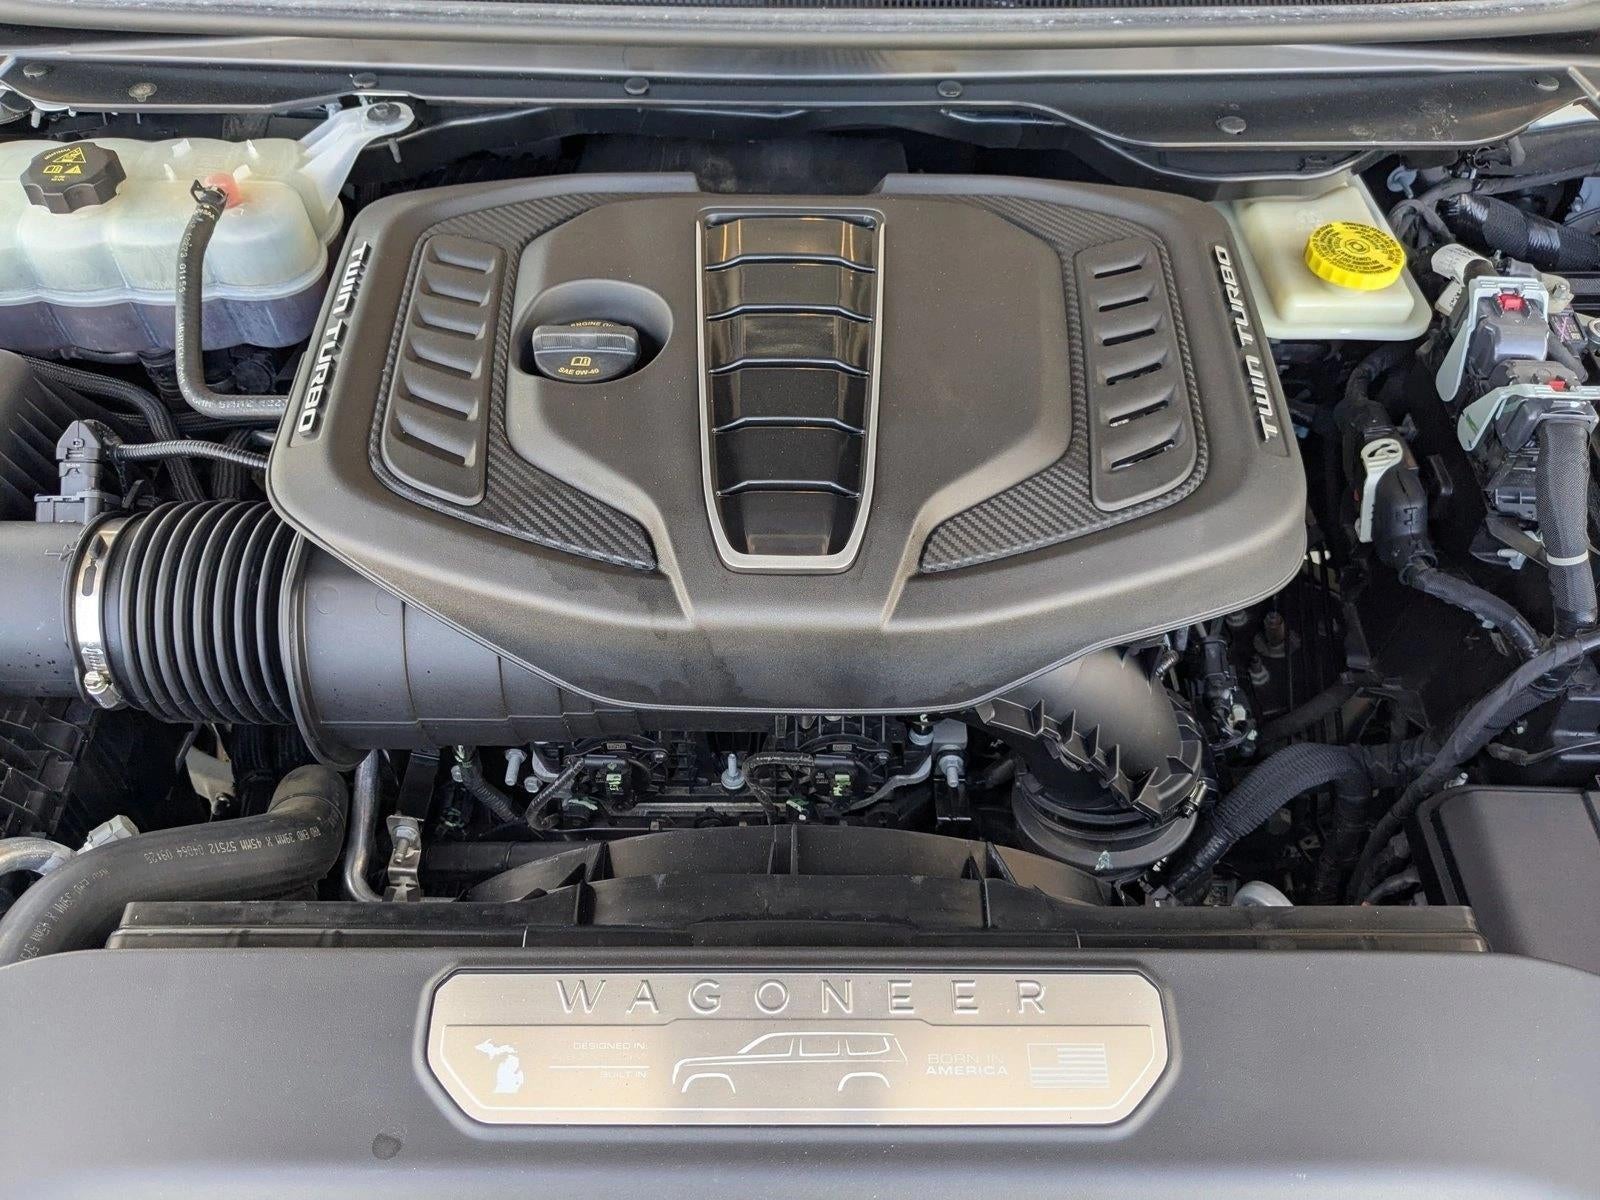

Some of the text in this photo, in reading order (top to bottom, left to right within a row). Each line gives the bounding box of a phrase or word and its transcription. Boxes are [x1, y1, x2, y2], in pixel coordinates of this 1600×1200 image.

[298, 241, 368, 433] TWIN TURBO
[1215, 245, 1278, 442] TWIN TURBO
[558, 367, 574, 375] SAE
[557, 979, 1046, 1014] WAGONEER
[573, 1041, 631, 1050] DESIGNED
[927, 1053, 979, 1064] BORN
[926, 1065, 1009, 1076] AMERICA
